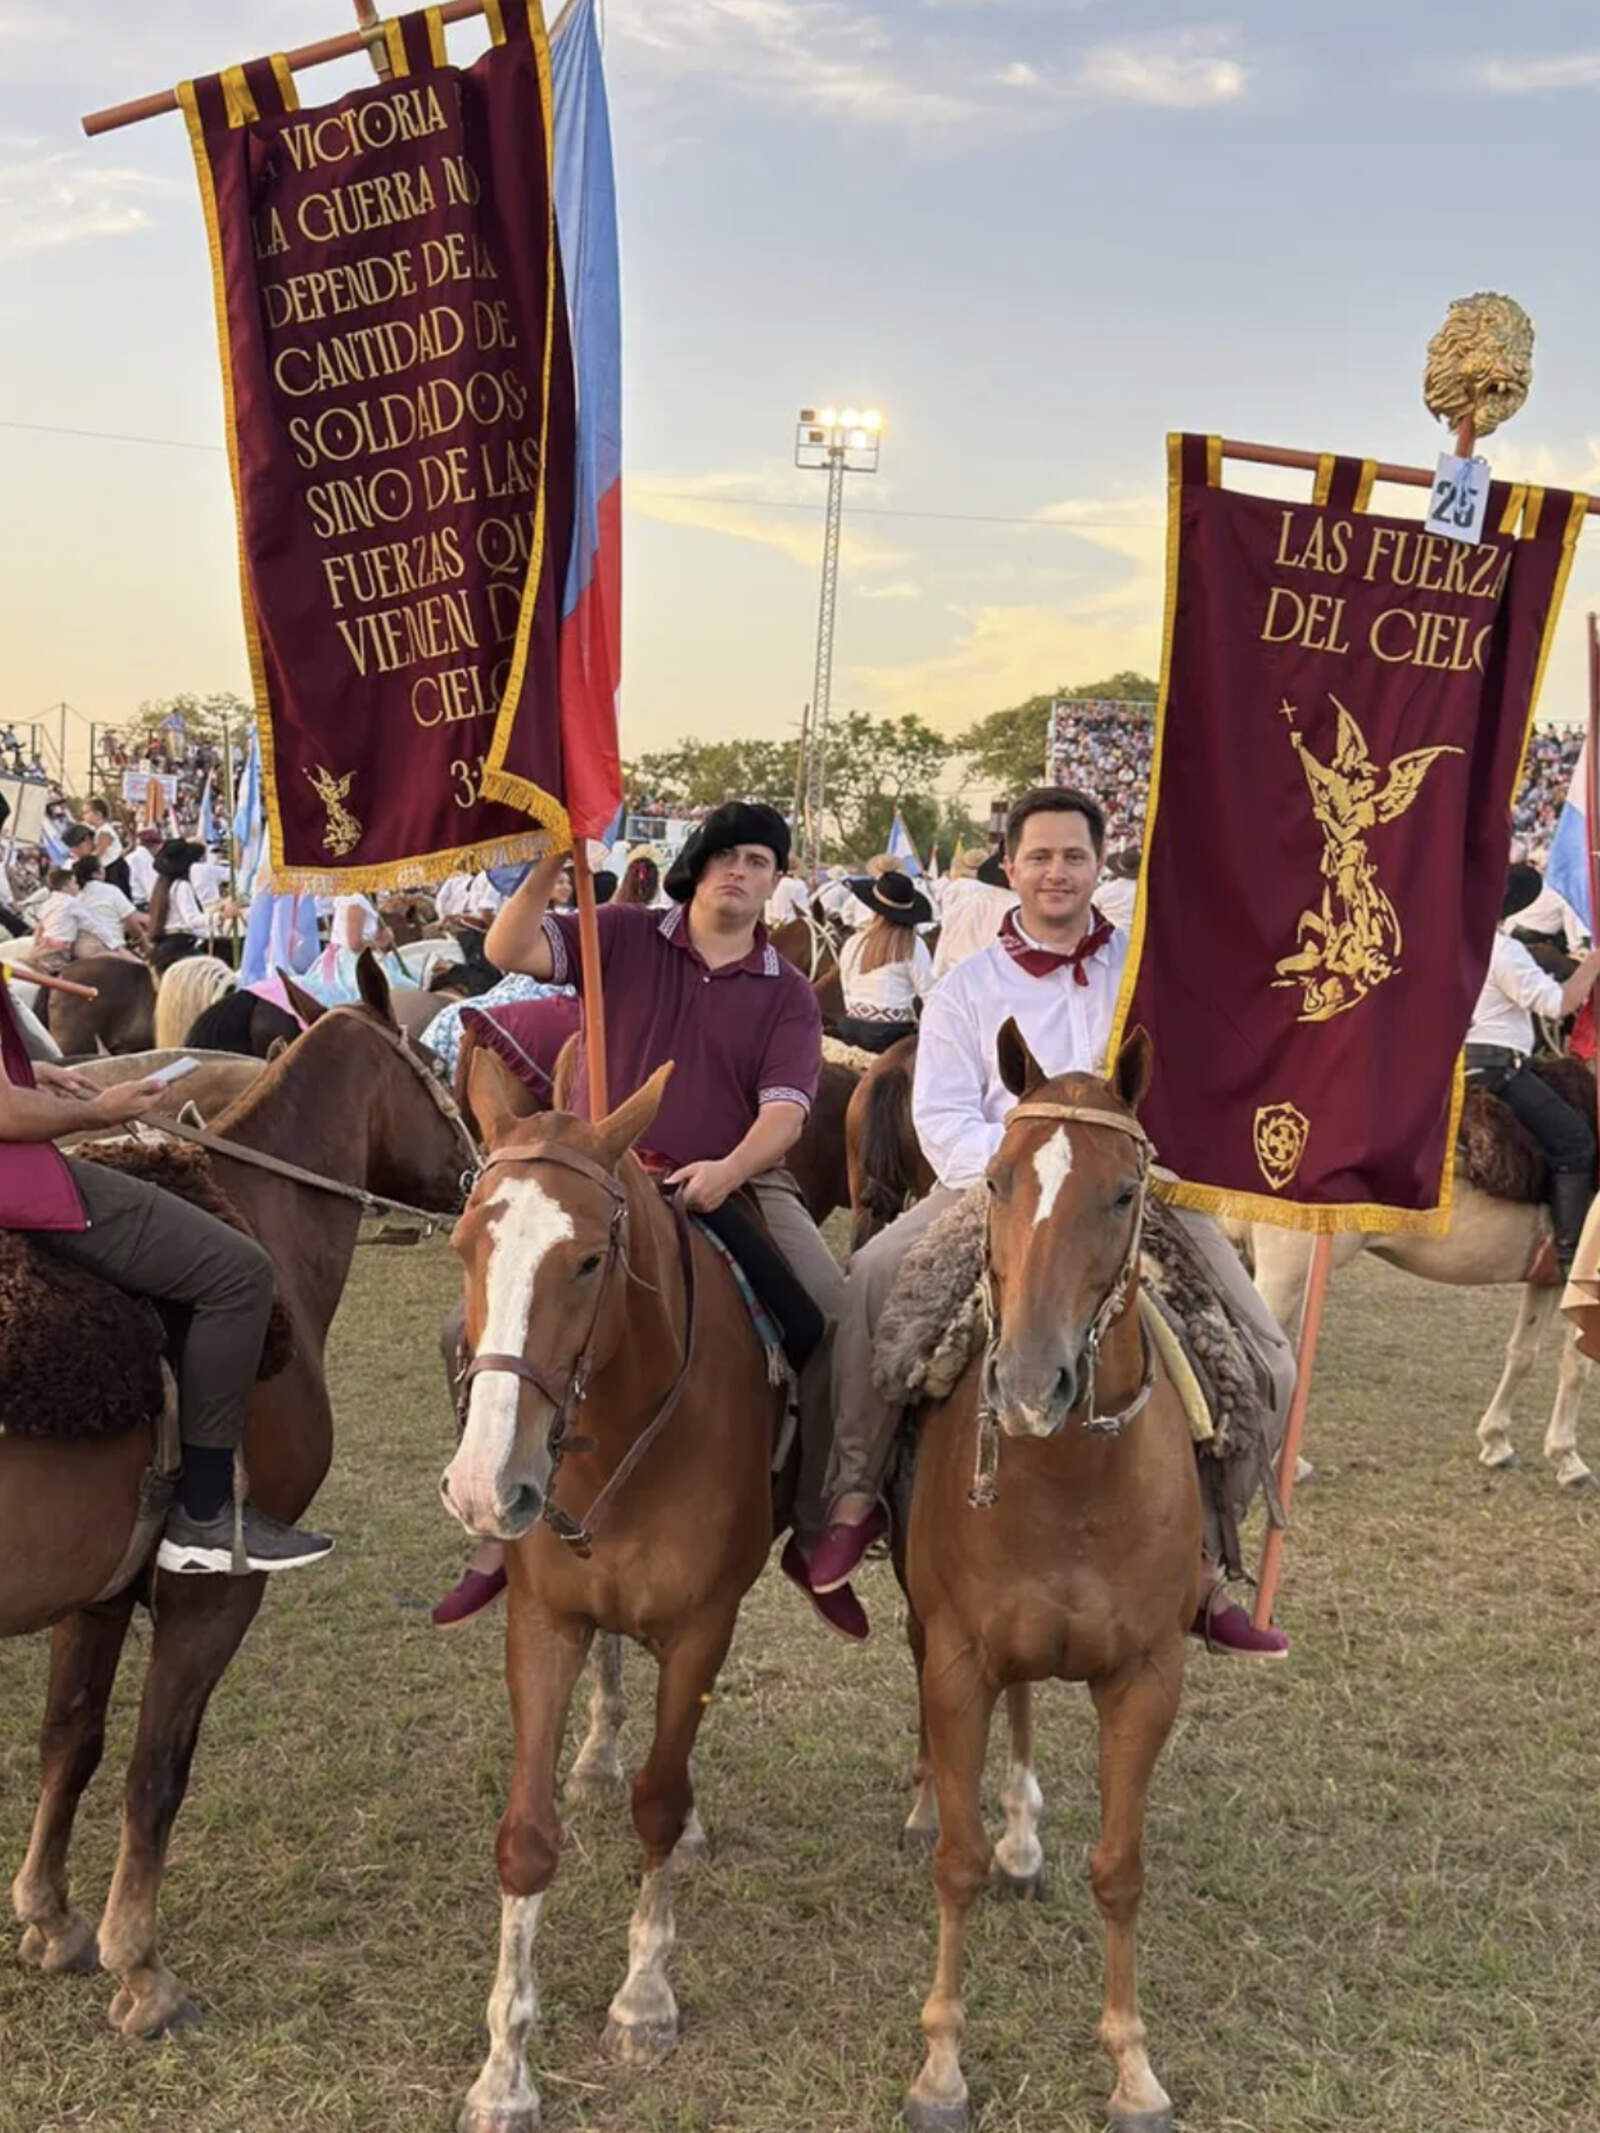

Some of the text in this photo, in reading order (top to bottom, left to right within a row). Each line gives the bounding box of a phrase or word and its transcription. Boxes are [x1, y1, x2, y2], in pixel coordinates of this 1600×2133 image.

[281, 85, 448, 172] VICTORIA
[252, 206, 291, 259] LA
[298, 164, 436, 242] GUERRA
[263, 250, 417, 329] DEPENDE
[421, 233, 471, 287] DE
[274, 300, 517, 397] CANTIDAD DE
[306, 437, 540, 539] SINO DE LAS
[322, 526, 464, 609] FUERZAS
[1275, 510, 1353, 575] LAS
[337, 590, 479, 677] VIENEN
[1261, 587, 1349, 654] DEL
